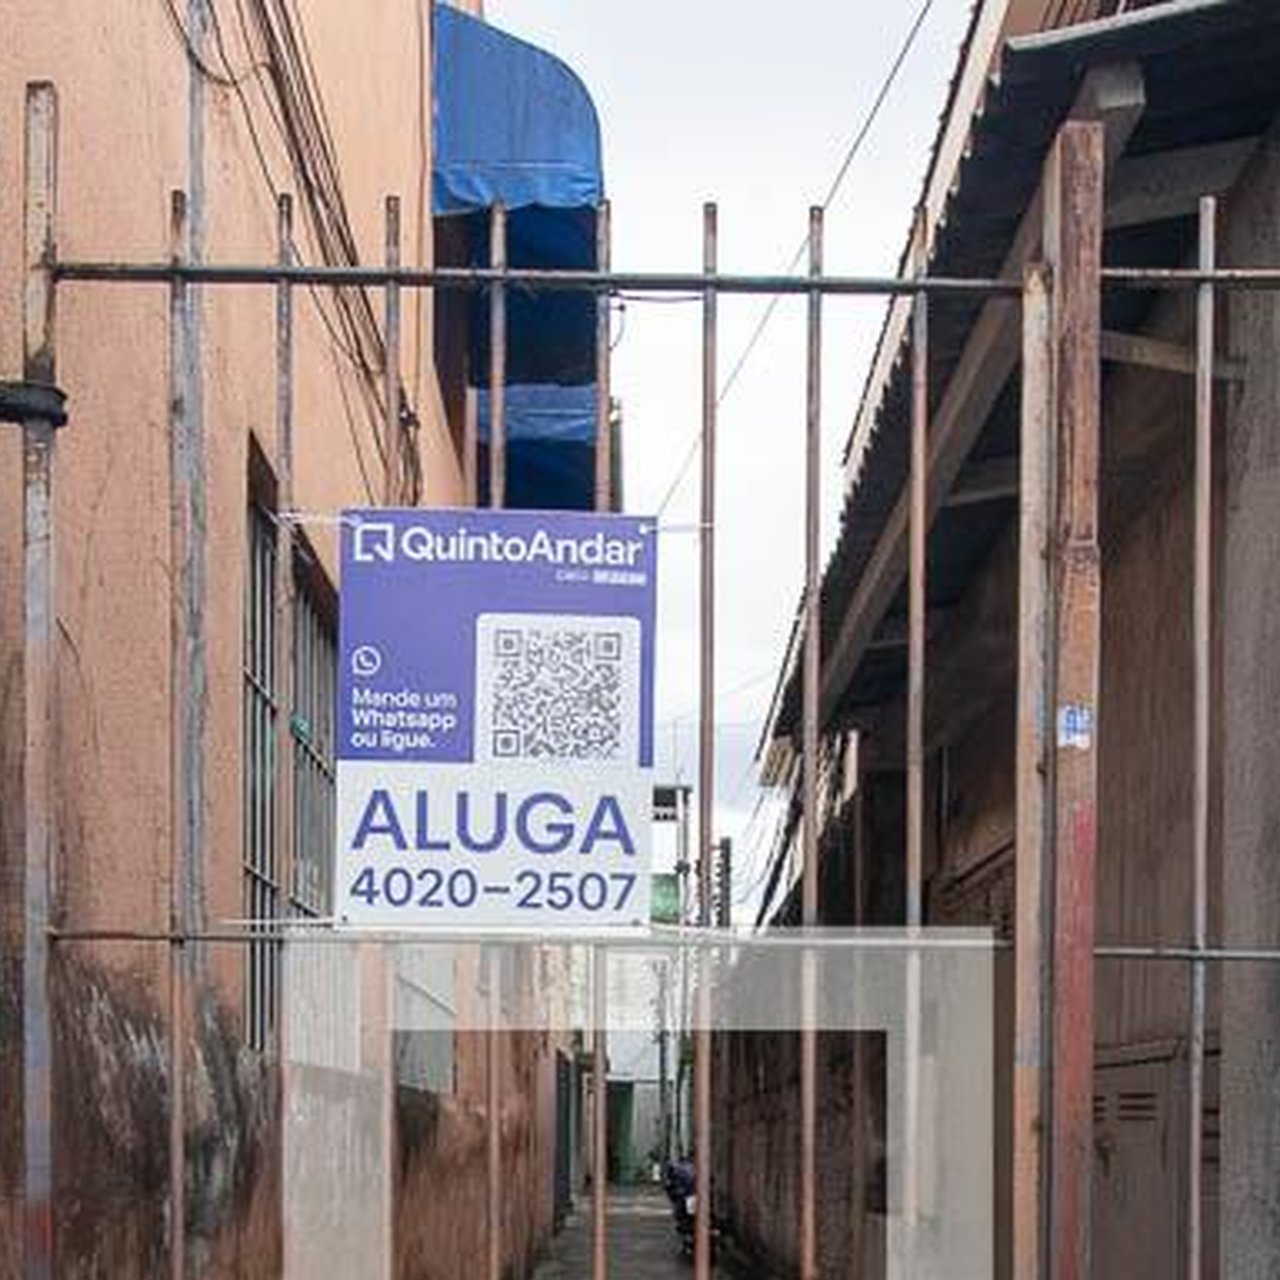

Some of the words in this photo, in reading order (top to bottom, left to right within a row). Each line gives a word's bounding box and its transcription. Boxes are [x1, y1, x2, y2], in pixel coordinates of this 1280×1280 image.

[401, 526, 643, 566] QuintoAndar
[352, 687, 420, 708] Mande
[352, 708, 456, 732] Whatsapp
[351, 732, 378, 748] ou
[350, 789, 636, 855] ALUGA
[349, 866, 637, 911] 4020-2507
